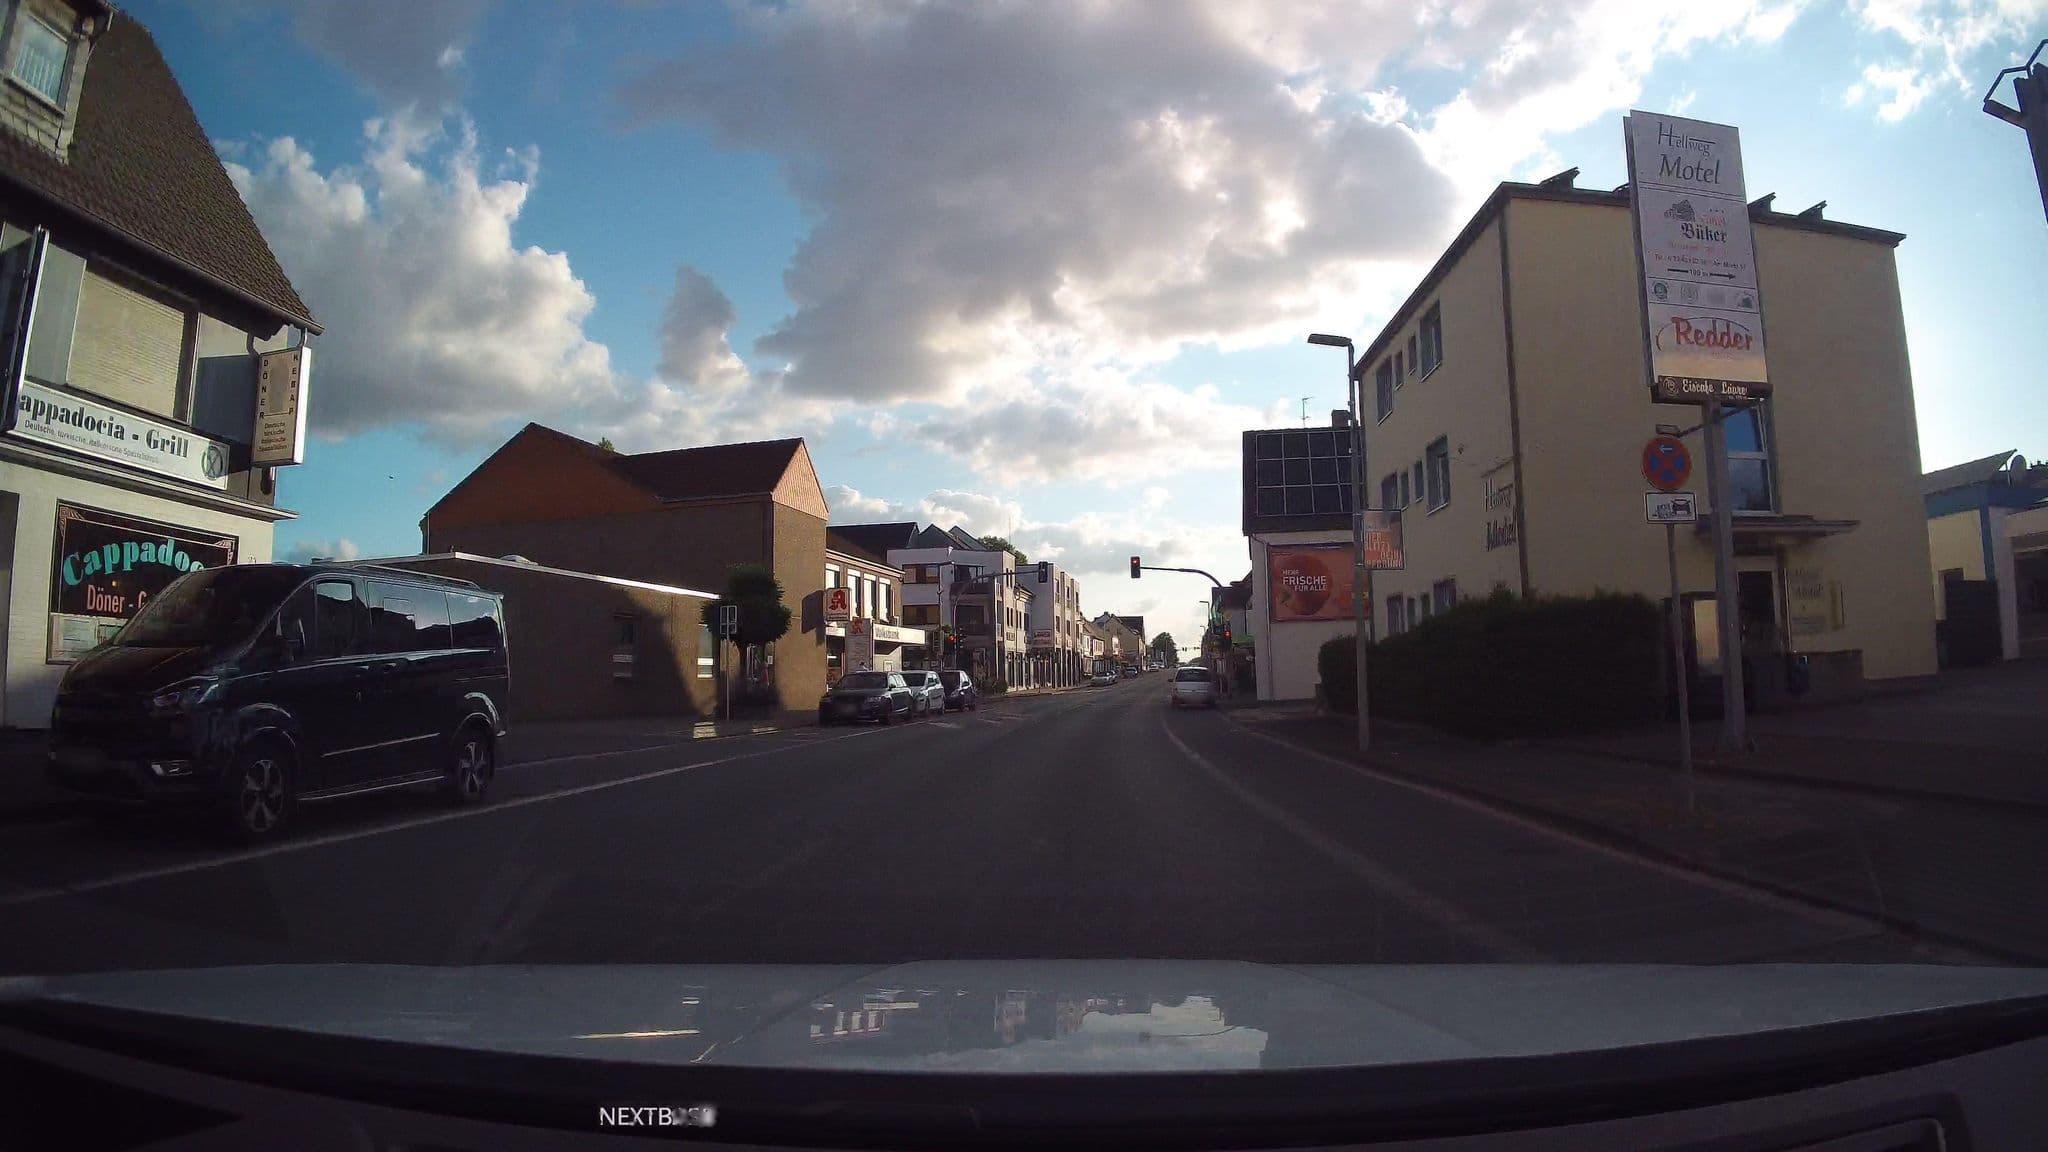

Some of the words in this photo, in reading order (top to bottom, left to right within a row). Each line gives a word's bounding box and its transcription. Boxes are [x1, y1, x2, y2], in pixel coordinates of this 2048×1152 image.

[1657, 122, 1713, 157] Hellweg
[1659, 153, 1720, 184] Motel
[1681, 222, 1727, 243] Büker
[1671, 316, 1752, 350] Redder
[259, 359, 268, 419] DÖNER
[289, 354, 298, 415] KEBAP
[145, 428, 189, 458] Grill
[1282, 575, 1327, 585] FRISCHE
[1309, 584, 1327, 592] ALLE
[87, 584, 125, 613] Döner
